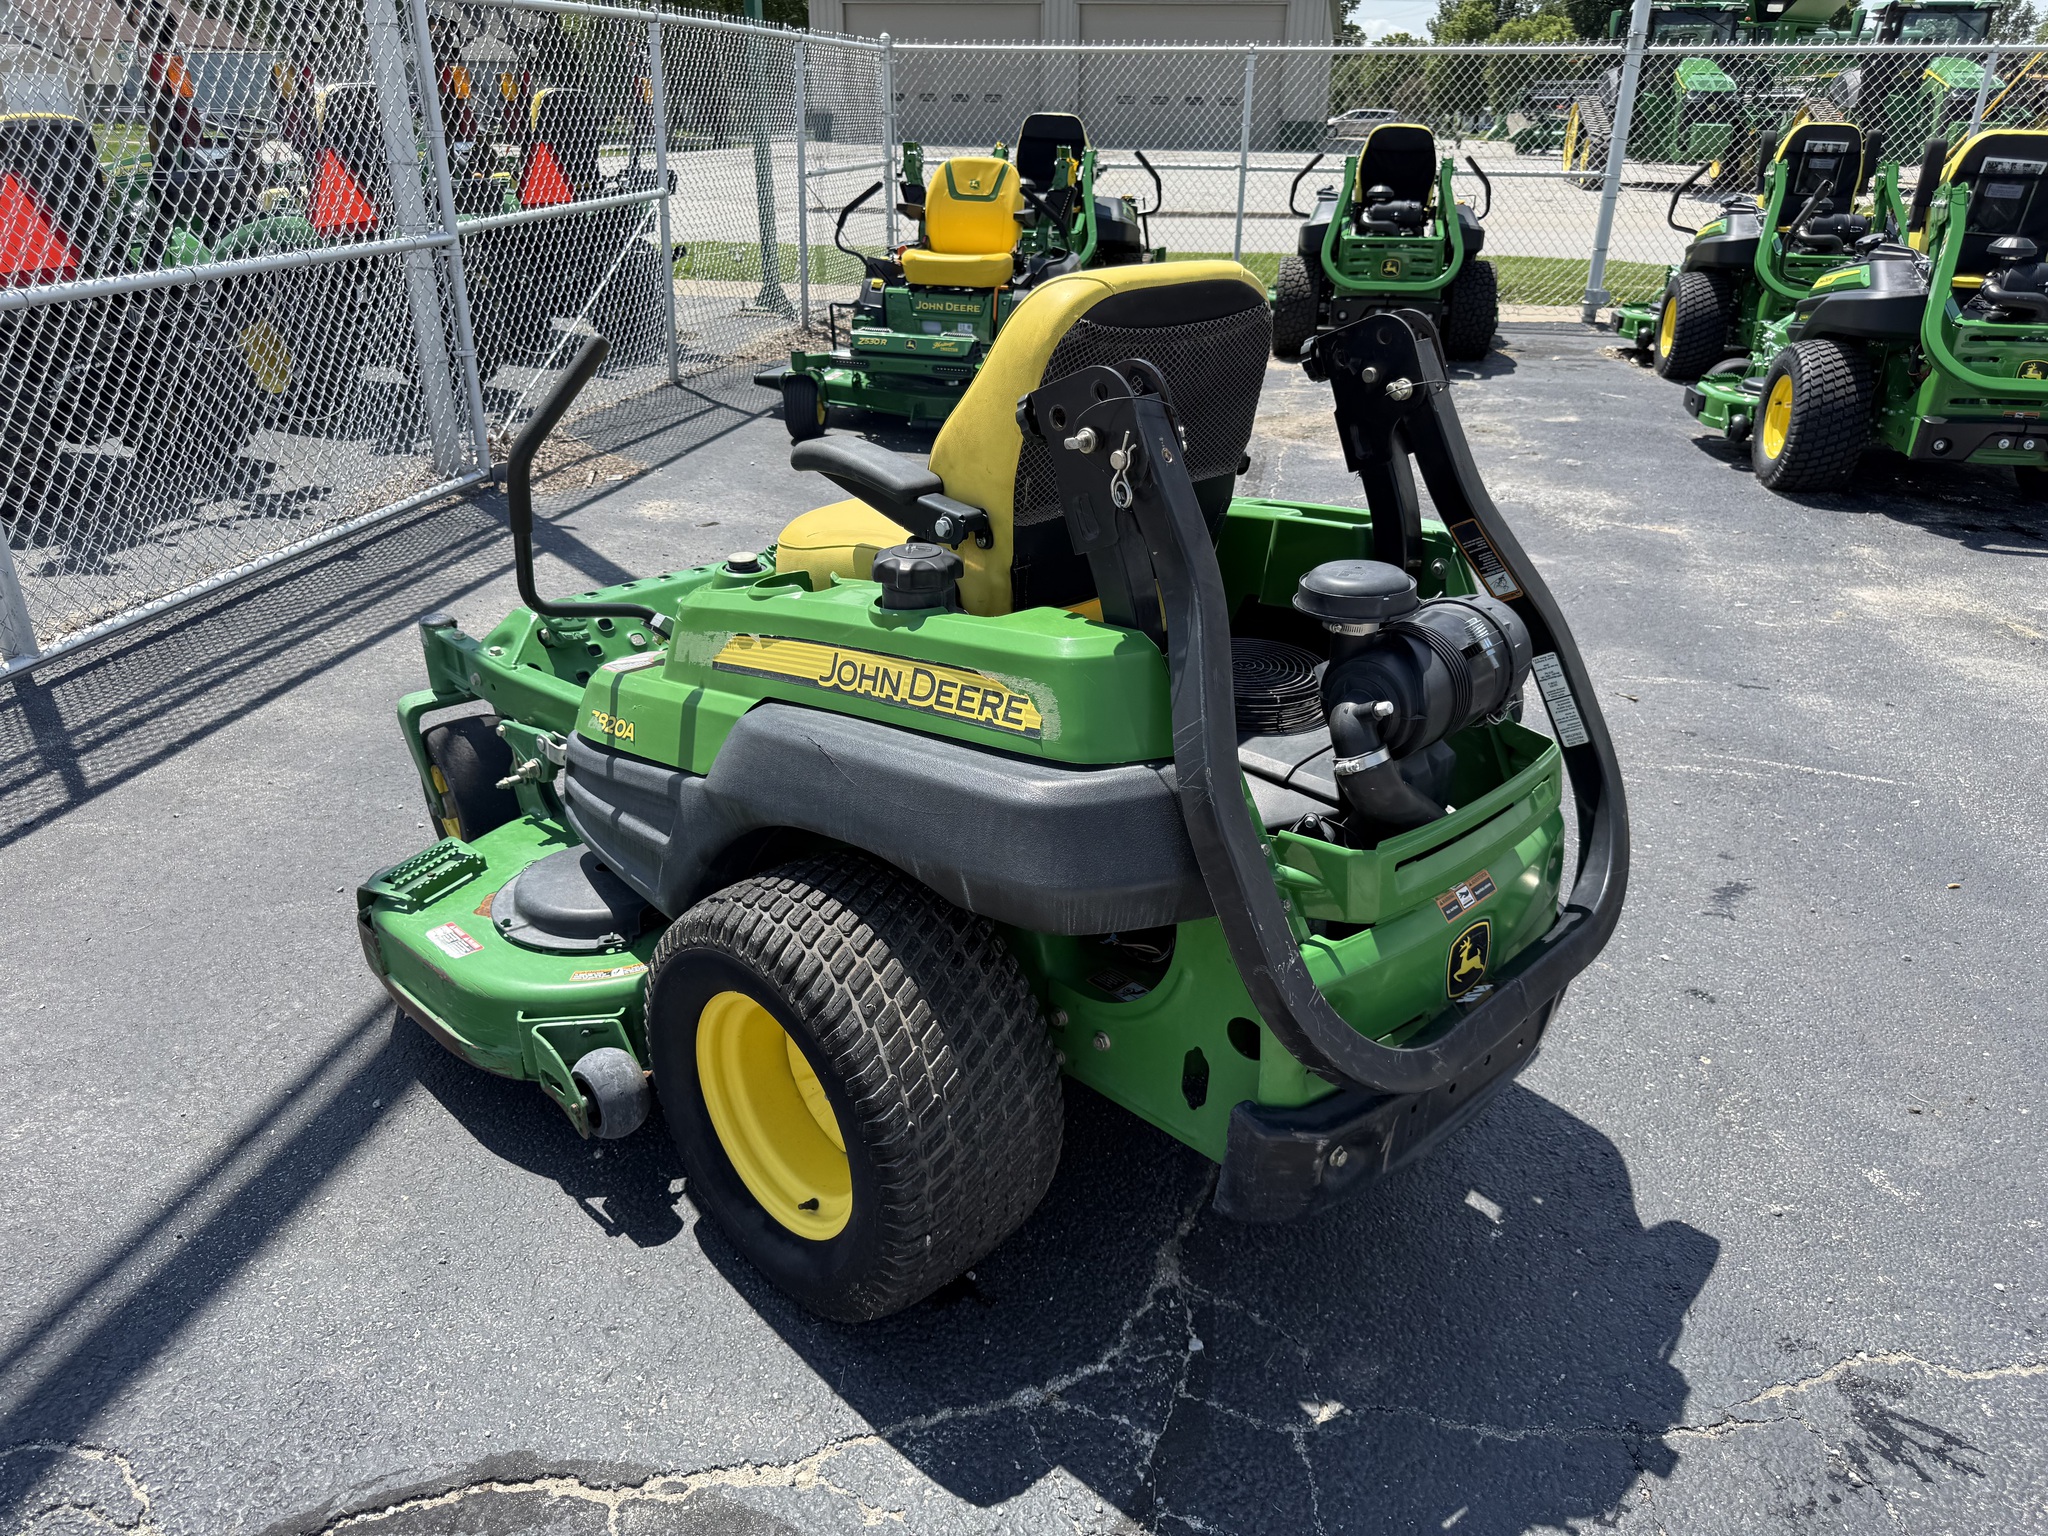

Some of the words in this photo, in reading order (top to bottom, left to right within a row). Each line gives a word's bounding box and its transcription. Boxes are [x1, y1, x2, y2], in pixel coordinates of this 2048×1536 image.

[915, 300, 944, 311] JOHN
[945, 302, 981, 313] DEERE
[818, 652, 904, 700] JOHN
[907, 667, 1030, 729] DEERE
